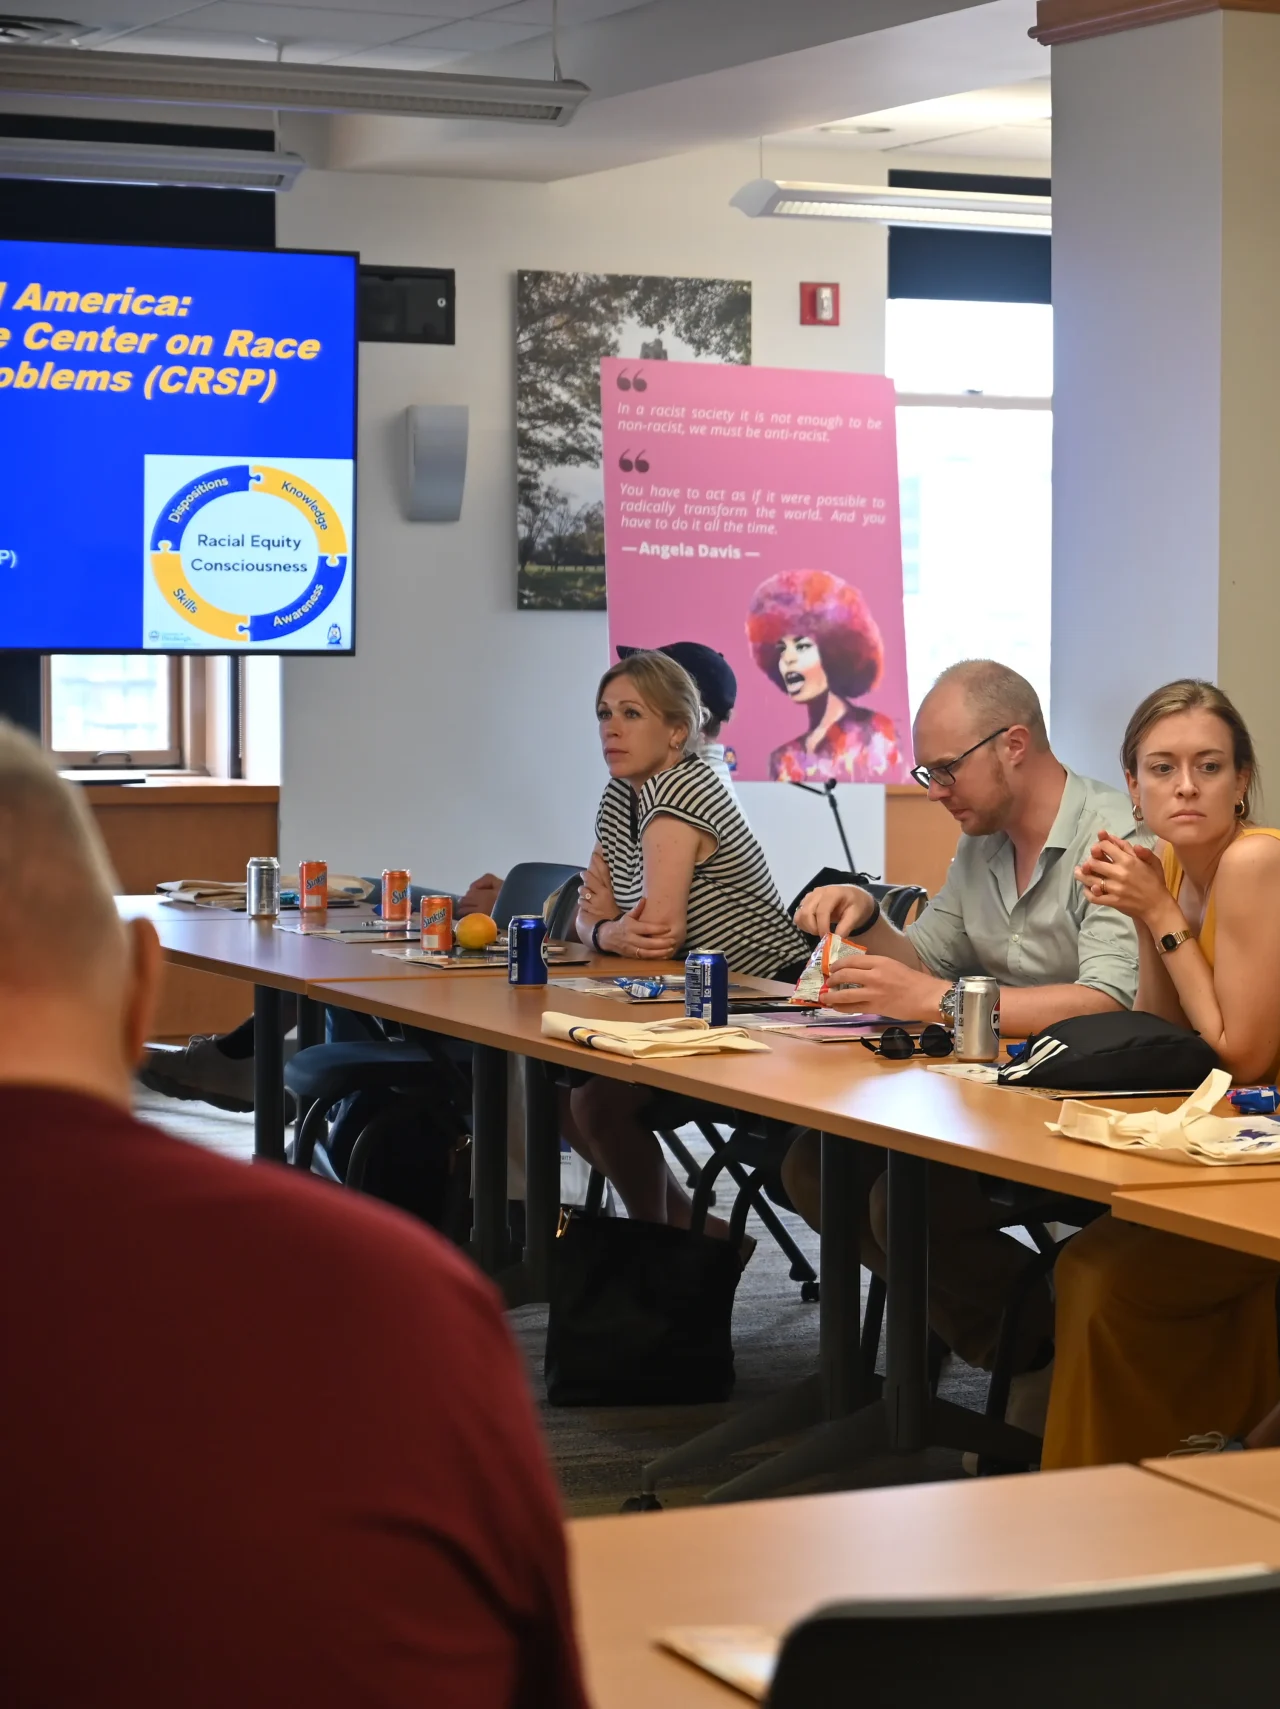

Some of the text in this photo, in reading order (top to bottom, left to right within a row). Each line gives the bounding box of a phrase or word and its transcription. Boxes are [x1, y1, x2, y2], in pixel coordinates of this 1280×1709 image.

[12, 282, 193, 317] America:
[23, 321, 158, 355] Center
[166, 333, 213, 357] on
[223, 329, 321, 361] Race
[143, 365, 278, 403] (CRSP)
[617, 401, 883, 431] In a racist society it is not enough to be
[617, 420, 831, 443] non-racist, we must be anti-racist.
[168, 474, 230, 524] Dispositions
[279, 479, 329, 532] Knowledge
[620, 482, 886, 510] You have to act as if it were possible to
[620, 499, 886, 527] radically transform the world. And you
[621, 514, 778, 535] have to do it all the time.
[197, 533, 302, 551] Racial Equity
[190, 558, 308, 574] Consciousness
[172, 586, 199, 615] Skills
[272, 582, 325, 628] Awareness
